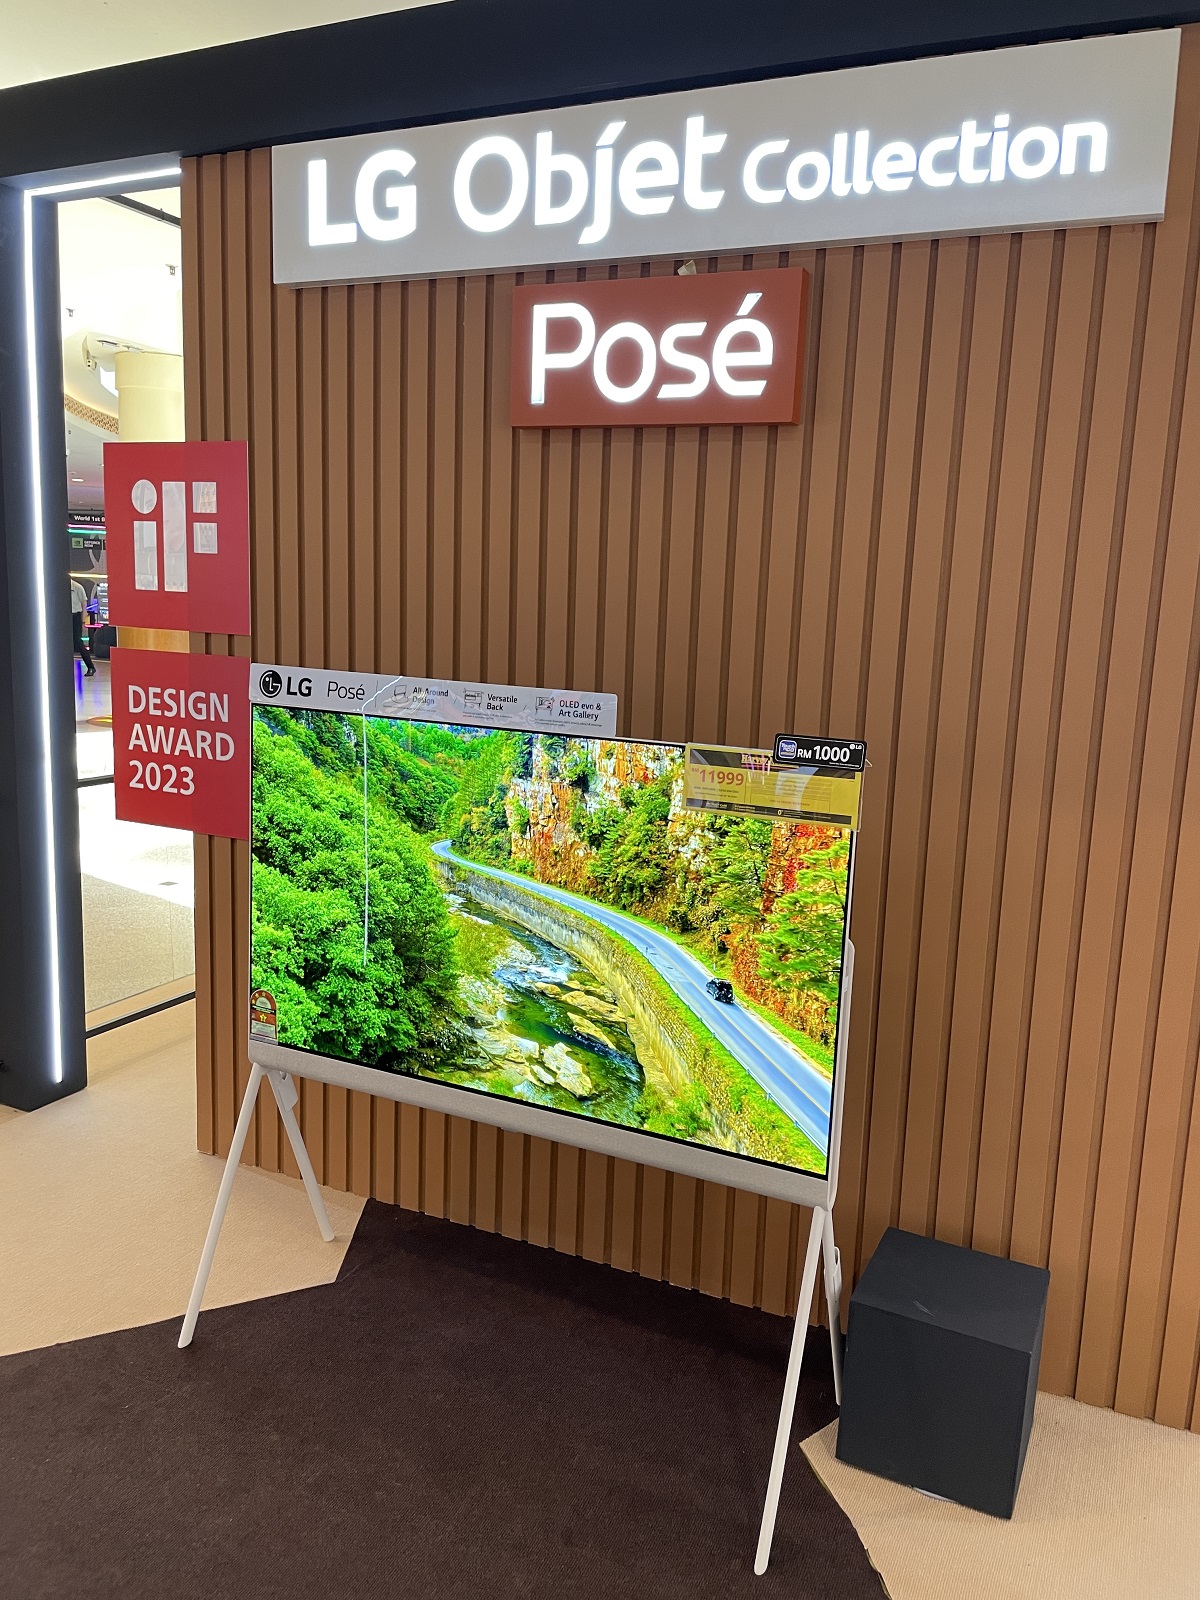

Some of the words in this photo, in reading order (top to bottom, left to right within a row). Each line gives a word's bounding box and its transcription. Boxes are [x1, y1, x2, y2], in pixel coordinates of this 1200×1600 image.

[307, 149, 417, 246] LG
[742, 113, 1108, 204] Collection
[530, 291, 774, 405] Posé
[131, 479, 218, 593] iF
[286, 676, 312, 697] LG
[327, 680, 366, 701] Posé
[487, 693, 518, 704] Versatile
[128, 684, 229, 723] DESIGN
[486, 702, 504, 711] Back
[558, 709, 571, 718] Art
[572, 711, 599, 721] Gallery
[559, 699, 580, 709] OLED
[581, 702, 595, 711] evo
[595, 702, 602, 711] &
[128, 723, 235, 762] AWARD
[797, 748, 812, 759] RM
[813, 745, 851, 763] 1,000
[129, 759, 195, 796] 2023
[700, 769, 744, 786] 11999
